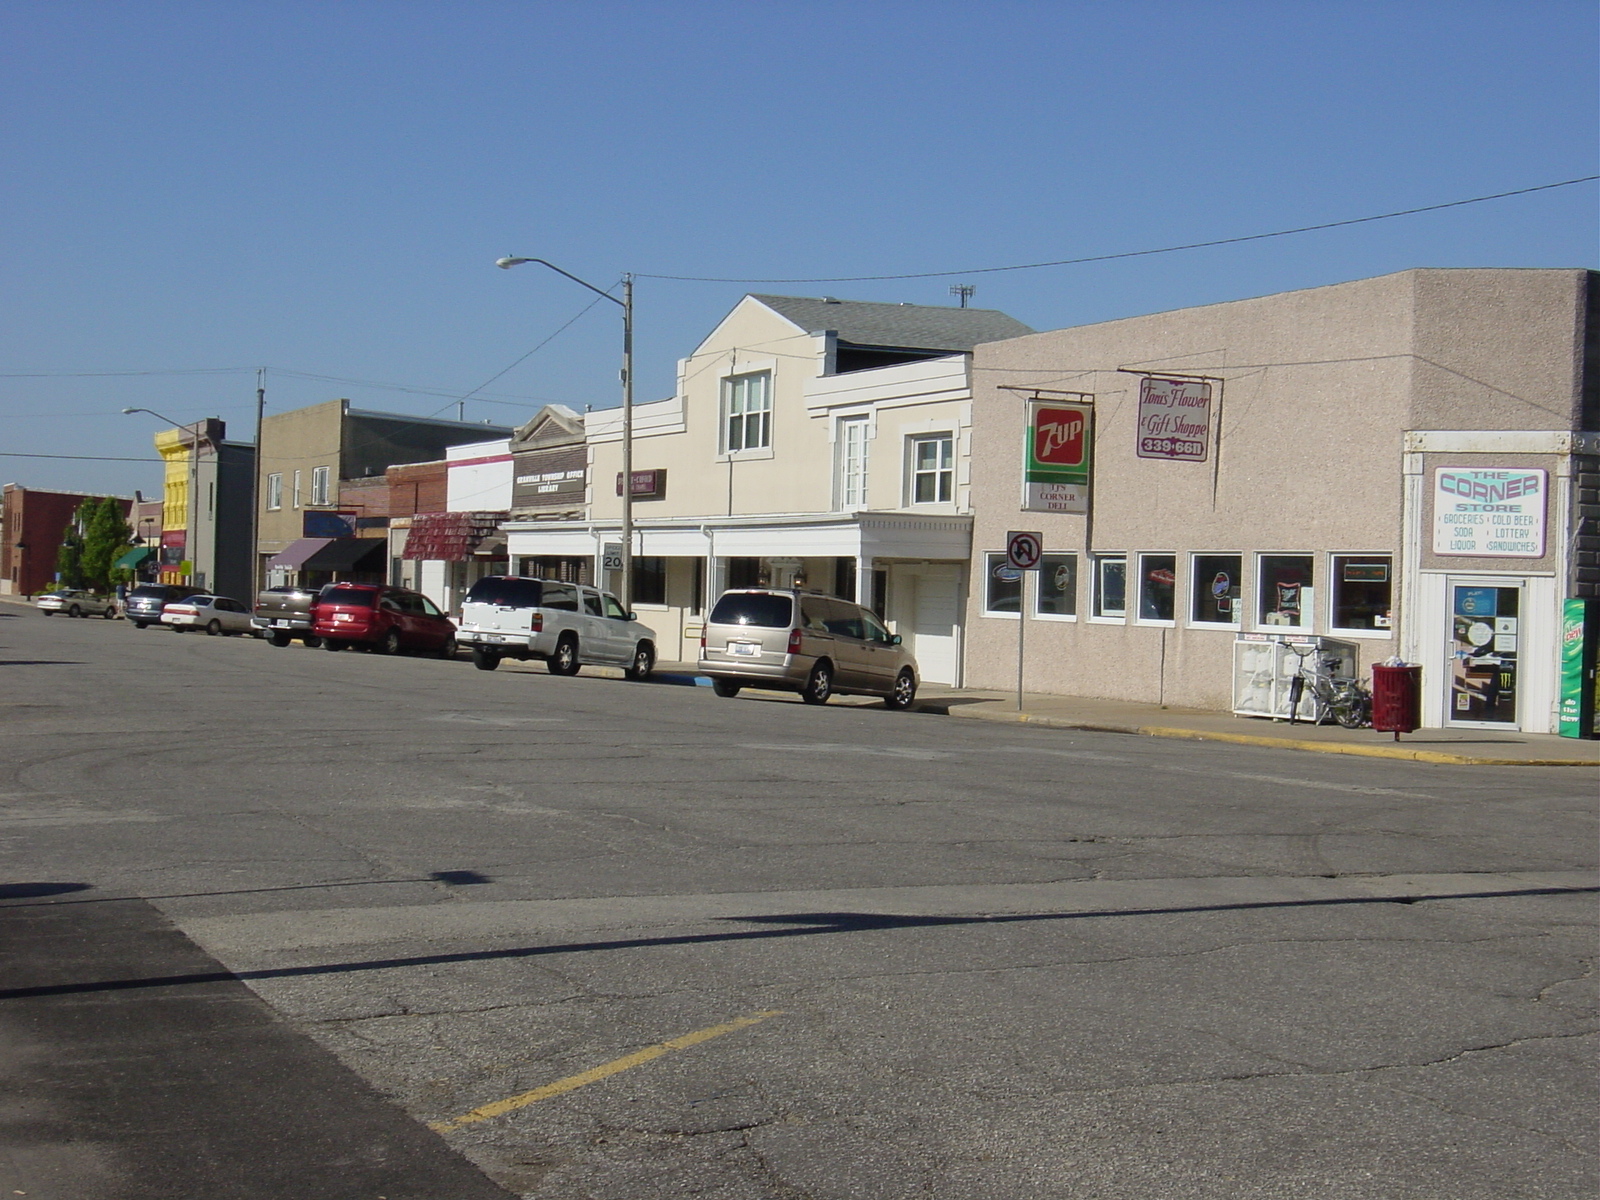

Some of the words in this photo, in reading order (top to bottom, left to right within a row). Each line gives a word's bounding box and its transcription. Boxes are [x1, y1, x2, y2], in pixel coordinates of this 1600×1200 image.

[1167, 388, 1209, 408] Flower
[1147, 413, 1171, 435] Gift
[1170, 414, 1207, 437] Shoppe
[541, 471, 565, 481] TOWNSHIP
[566, 469, 584, 479] OFFICE
[1470, 471, 1509, 480] THE
[537, 484, 559, 493] LIBRARY
[1440, 473, 1539, 503] CORNER
[1040, 492, 1075, 501] CORNER
[1048, 502, 1067, 510] DELI
[1455, 504, 1522, 513] STORE
[1444, 513, 1484, 525] GROCERIES
[1492, 515, 1511, 525] COLD
[1514, 515, 1534, 525] BEER
[1454, 527, 1473, 537] SODA
[1495, 528, 1530, 538] LOTTERY
[1450, 540, 1476, 550] LIQUOR
[1488, 540, 1536, 552] SANDWICHES
[605, 556, 621, 567] 20
